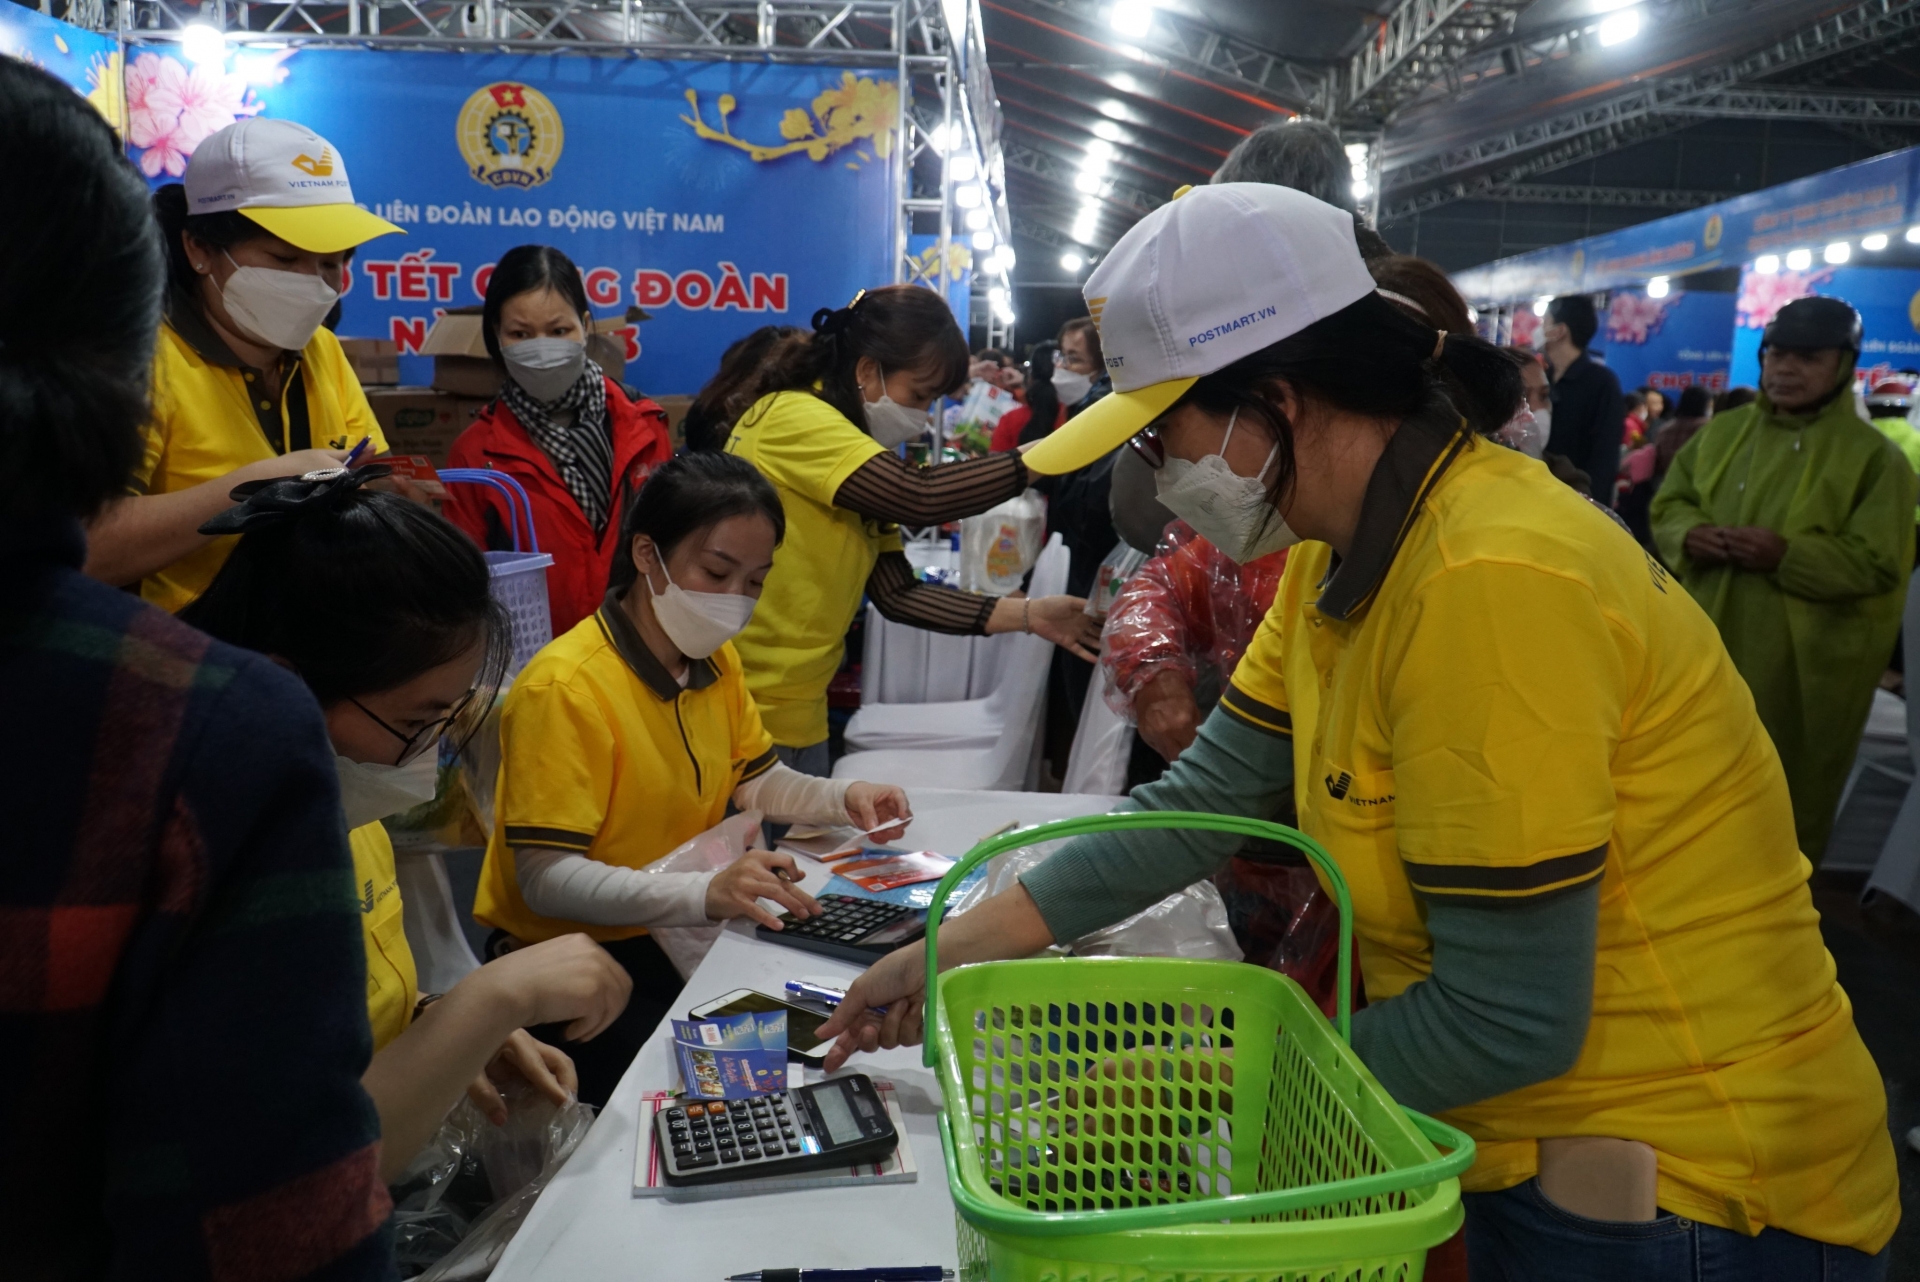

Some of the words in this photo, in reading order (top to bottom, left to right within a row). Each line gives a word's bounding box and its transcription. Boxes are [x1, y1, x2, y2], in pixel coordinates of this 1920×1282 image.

[288, 180, 334, 188] VIETNAM
[376, 199, 419, 223] LIÊN
[425, 202, 492, 225] ĐOÀN
[498, 208, 542, 227] LAO
[548, 204, 617, 234] ĐỘNG
[622, 206, 667, 236] VIỆT
[672, 213, 725, 233] NAM
[364, 248, 461, 301] TẾT
[632, 261, 788, 313] ĐOÀN
[1189, 305, 1277, 348] POSTMART.VN
